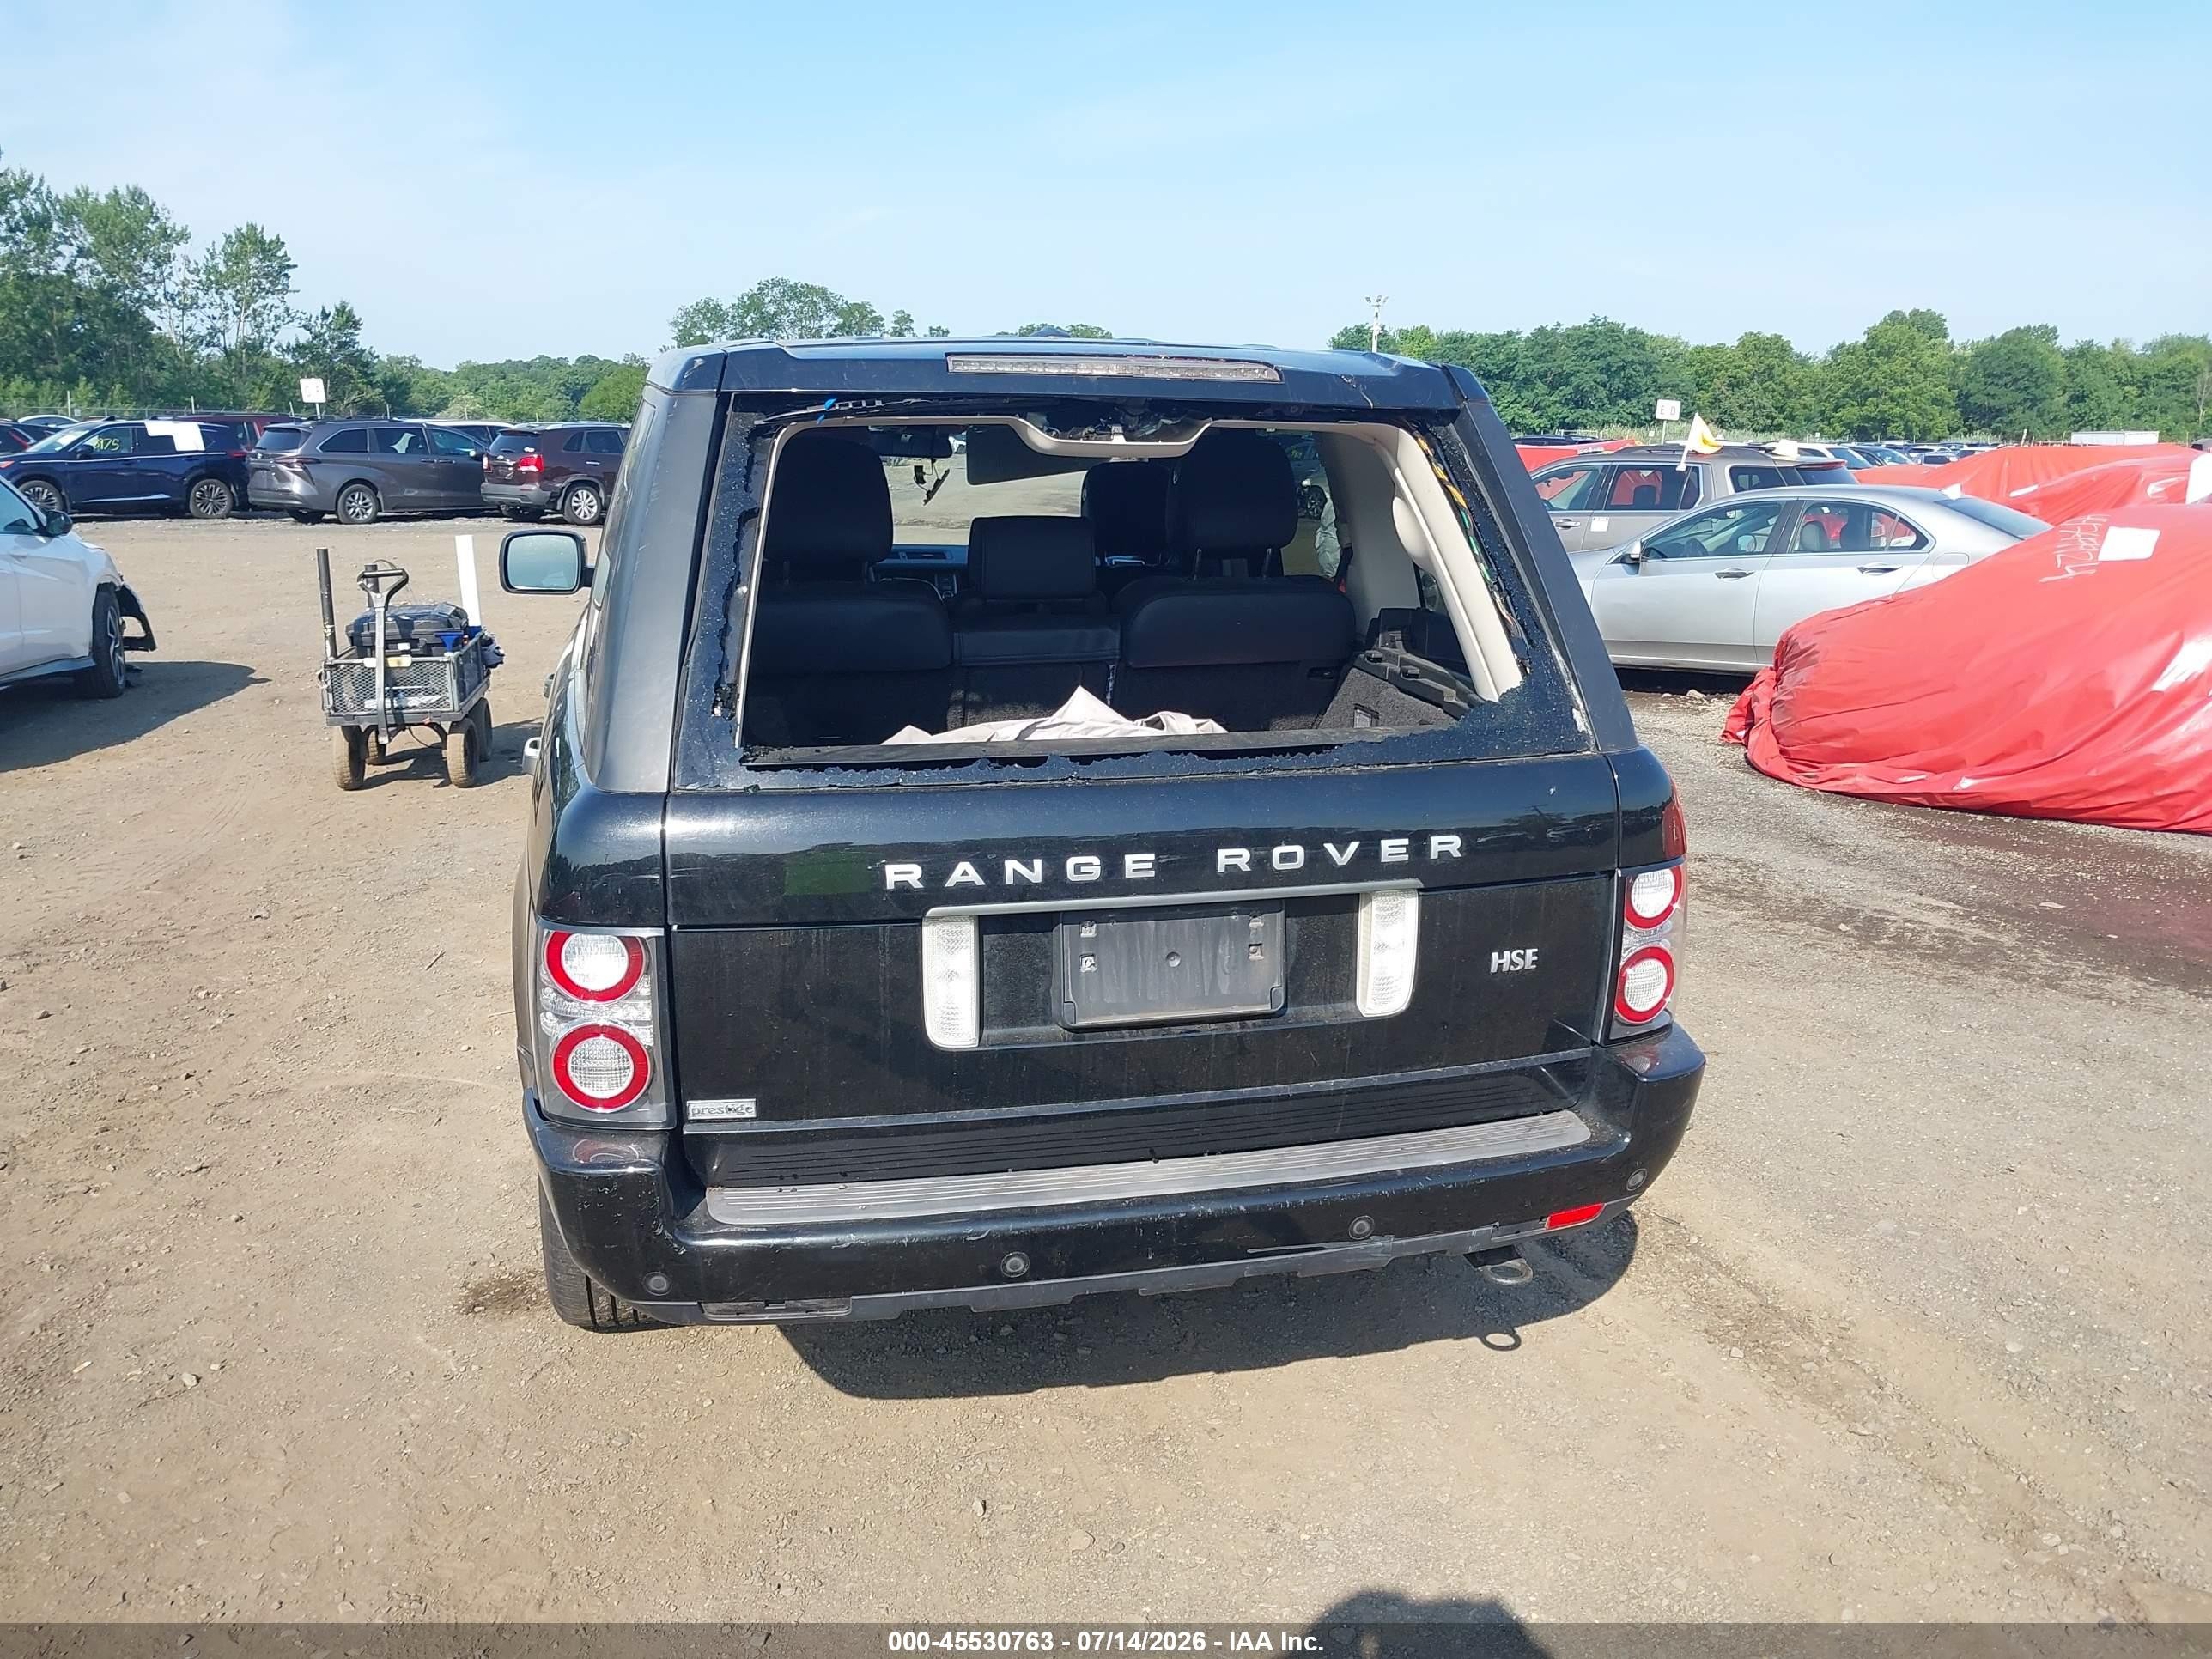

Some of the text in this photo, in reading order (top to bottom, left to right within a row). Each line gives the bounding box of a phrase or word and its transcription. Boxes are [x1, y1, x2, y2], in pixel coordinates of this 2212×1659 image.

[884, 835, 1462, 890] RANGE ROVER
[1490, 948, 1539, 973] HSE
